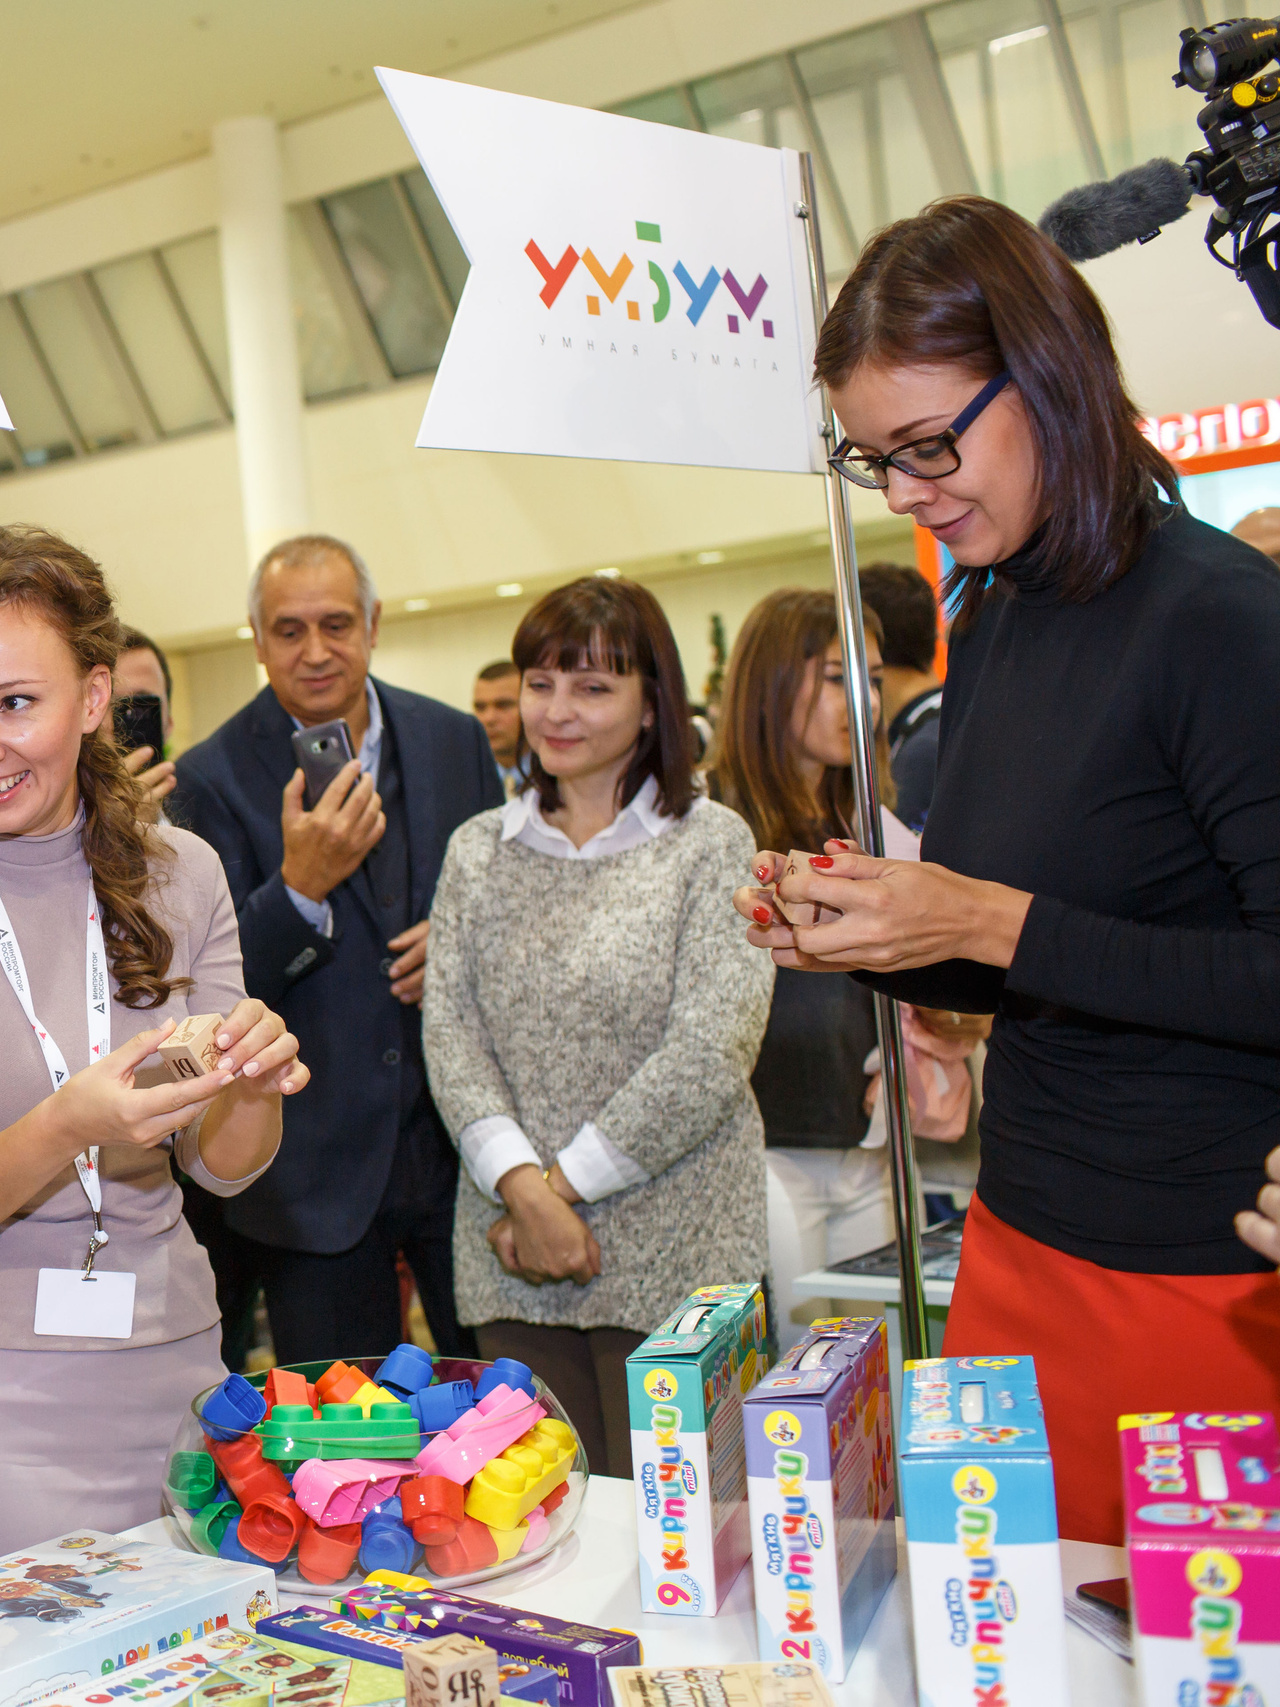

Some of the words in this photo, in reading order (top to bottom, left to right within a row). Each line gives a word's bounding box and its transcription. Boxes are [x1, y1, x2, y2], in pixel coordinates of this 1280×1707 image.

[539, 333, 639, 356] УМНАЯ
[671, 348, 779, 372] БУМАГА
[1, 942, 13, 972] РОССИИ
[6, 940, 24, 993] МИНПРОМТОРГ
[641, 1462, 661, 1519] Мягкие
[682, 1464, 697, 1492] mini
[763, 1513, 783, 1575] Мягкие
[808, 1518, 823, 1546] mini
[656, 1581, 692, 1607] 9
[101, 1643, 150, 1676] ЛОТО
[780, 1638, 811, 1659] 2
[448, 1670, 469, 1702] Я
